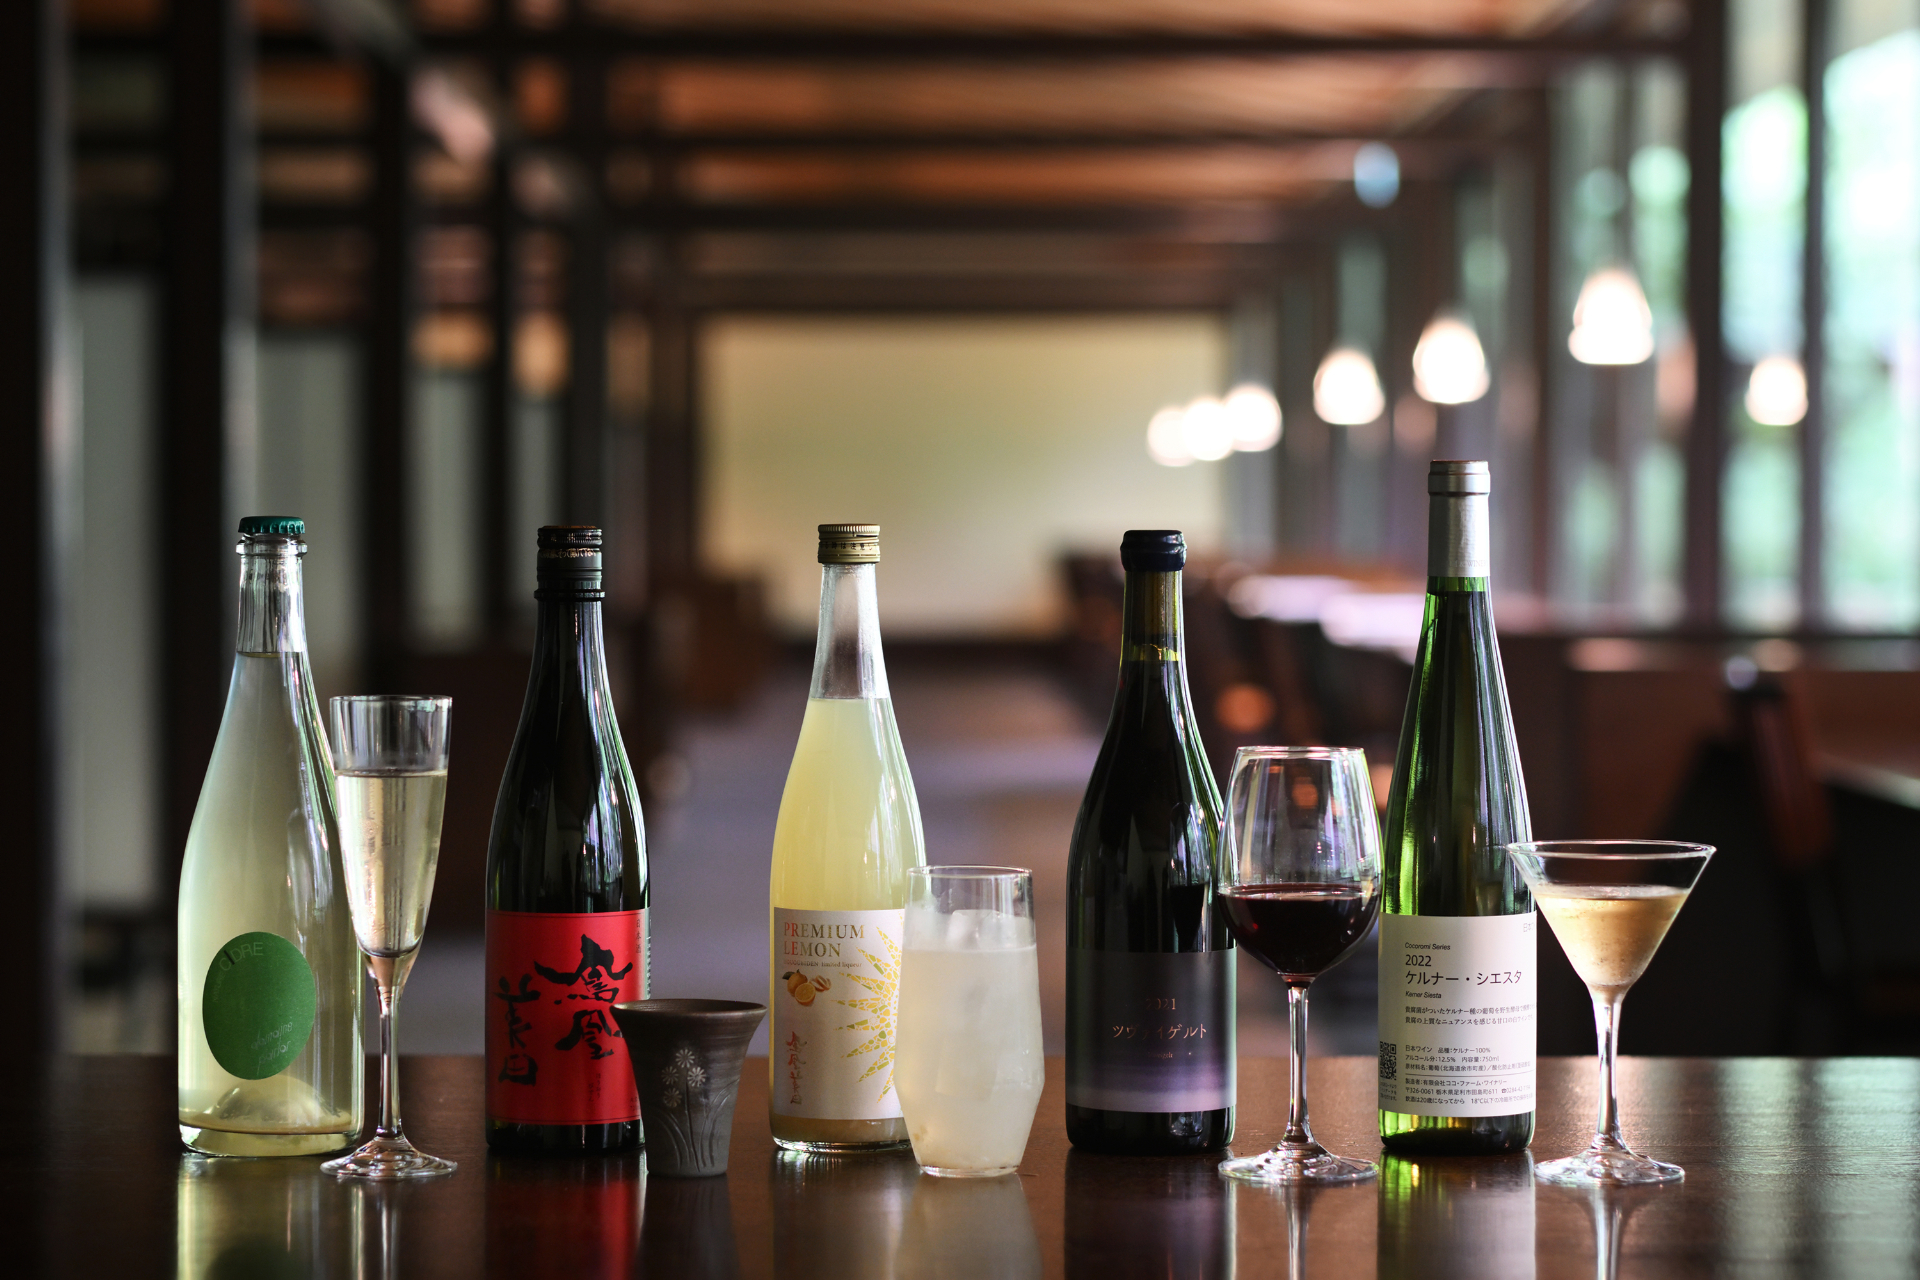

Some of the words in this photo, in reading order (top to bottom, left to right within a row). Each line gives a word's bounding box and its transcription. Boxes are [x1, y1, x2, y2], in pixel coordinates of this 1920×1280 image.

[783, 922, 865, 939] PREMIUM
[783, 940, 841, 958] LEMON
[1405, 942, 1431, 950] Cocoromi
[1431, 943, 1451, 951] Series
[219, 942, 264, 971] CIDRE
[1405, 954, 1432, 967] 2022
[842, 961, 862, 969] liqueur
[1405, 970, 1522, 986] ケルナー・シエスタ
[1423, 991, 1442, 999] Siesta
[251, 1021, 293, 1050] domaine
[1112, 1023, 1207, 1040] ツヴァイゲルト
[1405, 1045, 1433, 1053] 日本ワイン
[1405, 1055, 1456, 1063] アルコール分：12.5%
[1461, 1055, 1500, 1063] 内容量：750ml
[1405, 1096, 1465, 1105] 飲酒は20歳になってから
